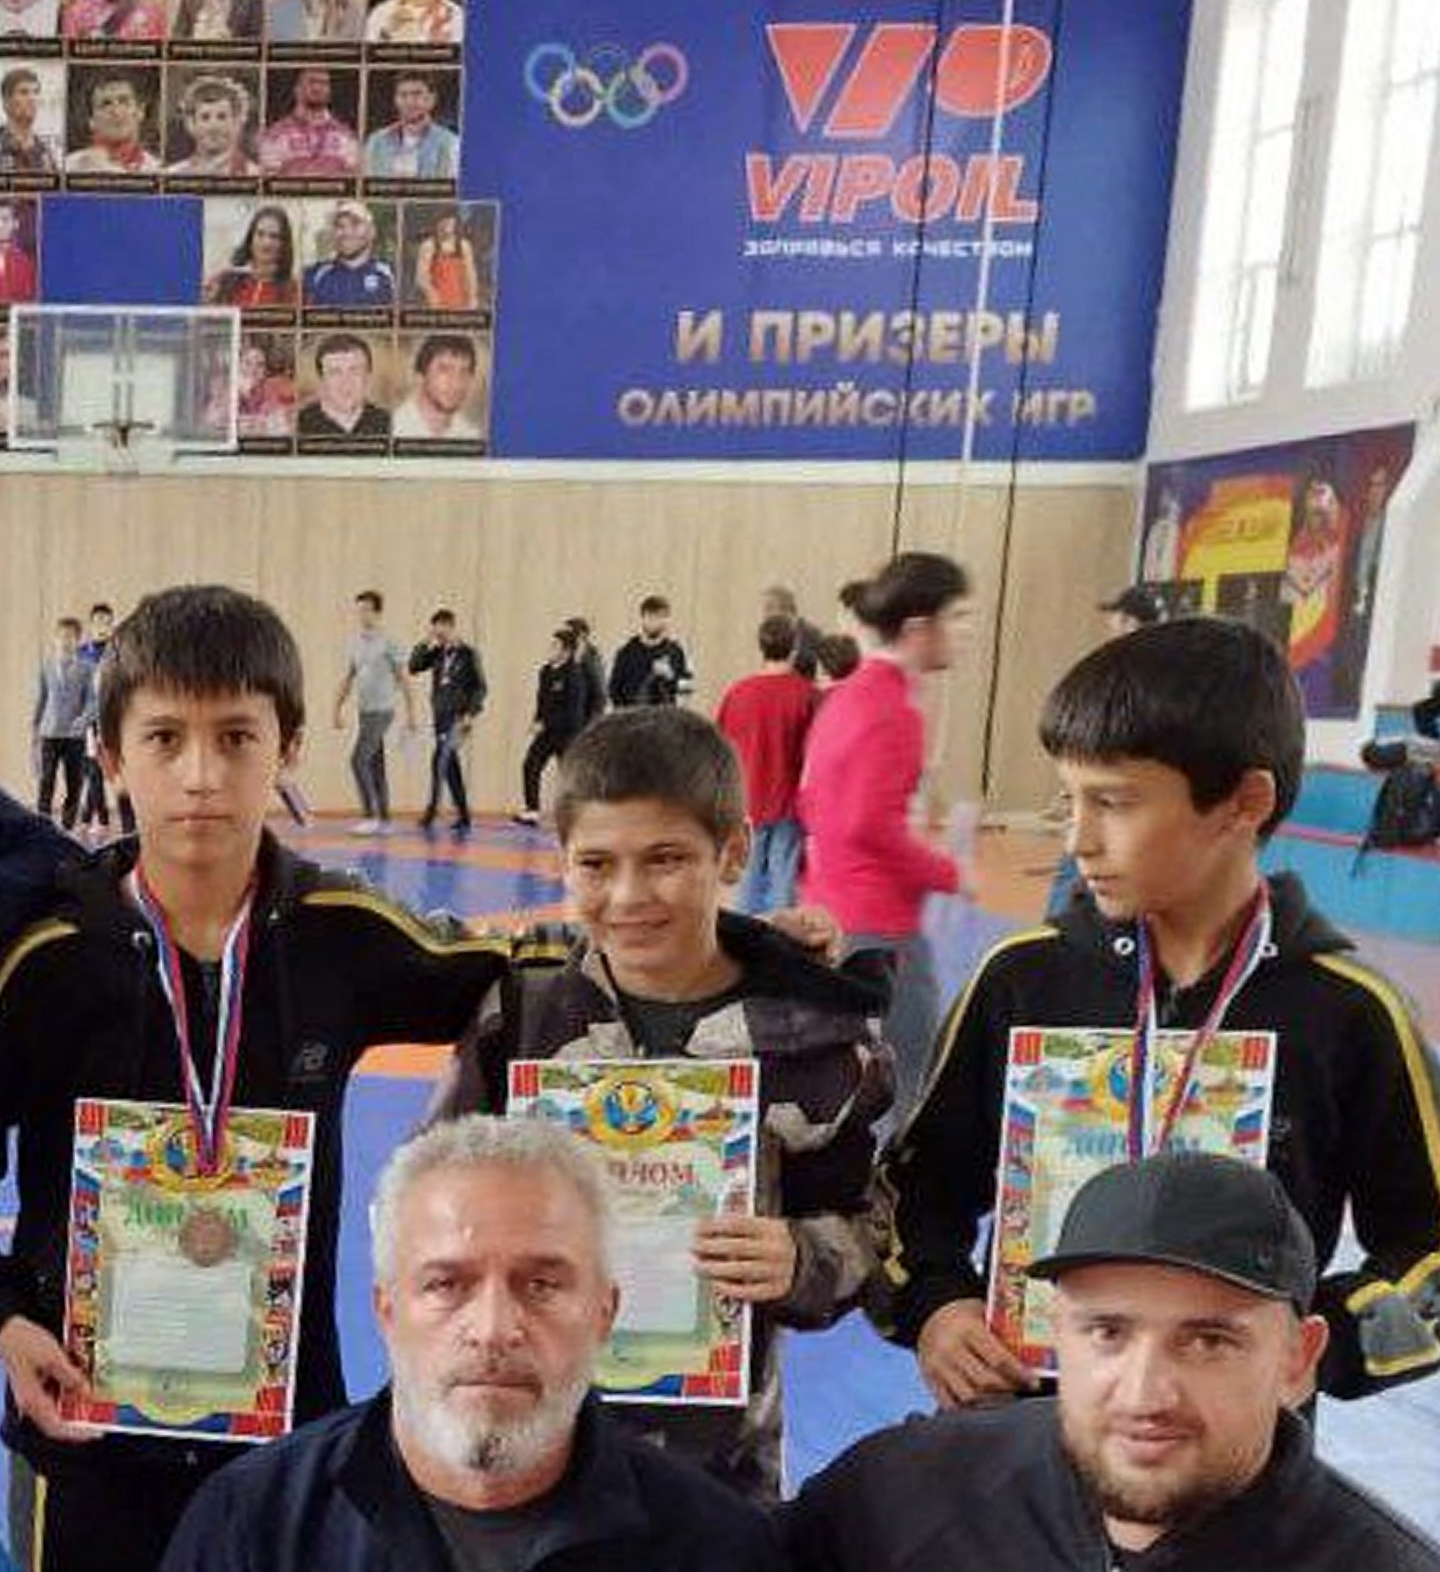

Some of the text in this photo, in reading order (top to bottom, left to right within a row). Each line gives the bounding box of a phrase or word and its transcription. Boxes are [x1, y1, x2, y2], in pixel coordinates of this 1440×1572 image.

[744, 152, 1040, 224] VIPOIL
[675, 310, 1060, 366] И ПРИЗЕРЫ
[618, 382, 1096, 428] ОЛИМПИЙСКИХ ИГР
